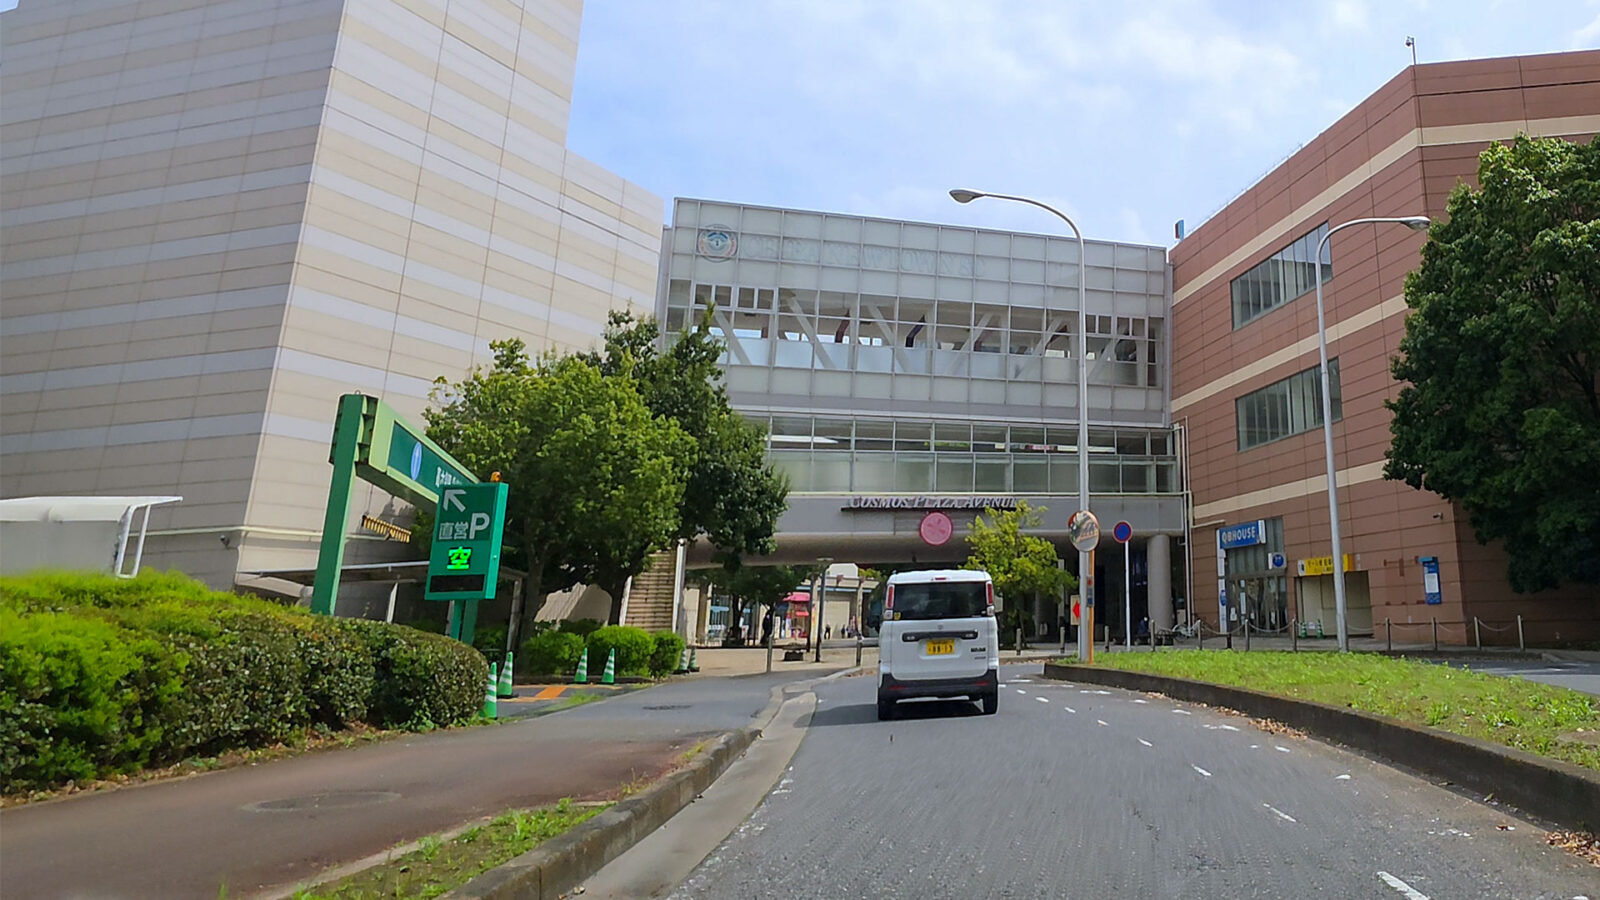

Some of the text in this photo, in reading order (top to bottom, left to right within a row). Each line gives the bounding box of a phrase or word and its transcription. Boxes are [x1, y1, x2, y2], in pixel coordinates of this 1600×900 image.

[850, 495, 908, 508] COSMOS
[913, 496, 957, 508] PLAZA
[447, 546, 471, 569] 空
